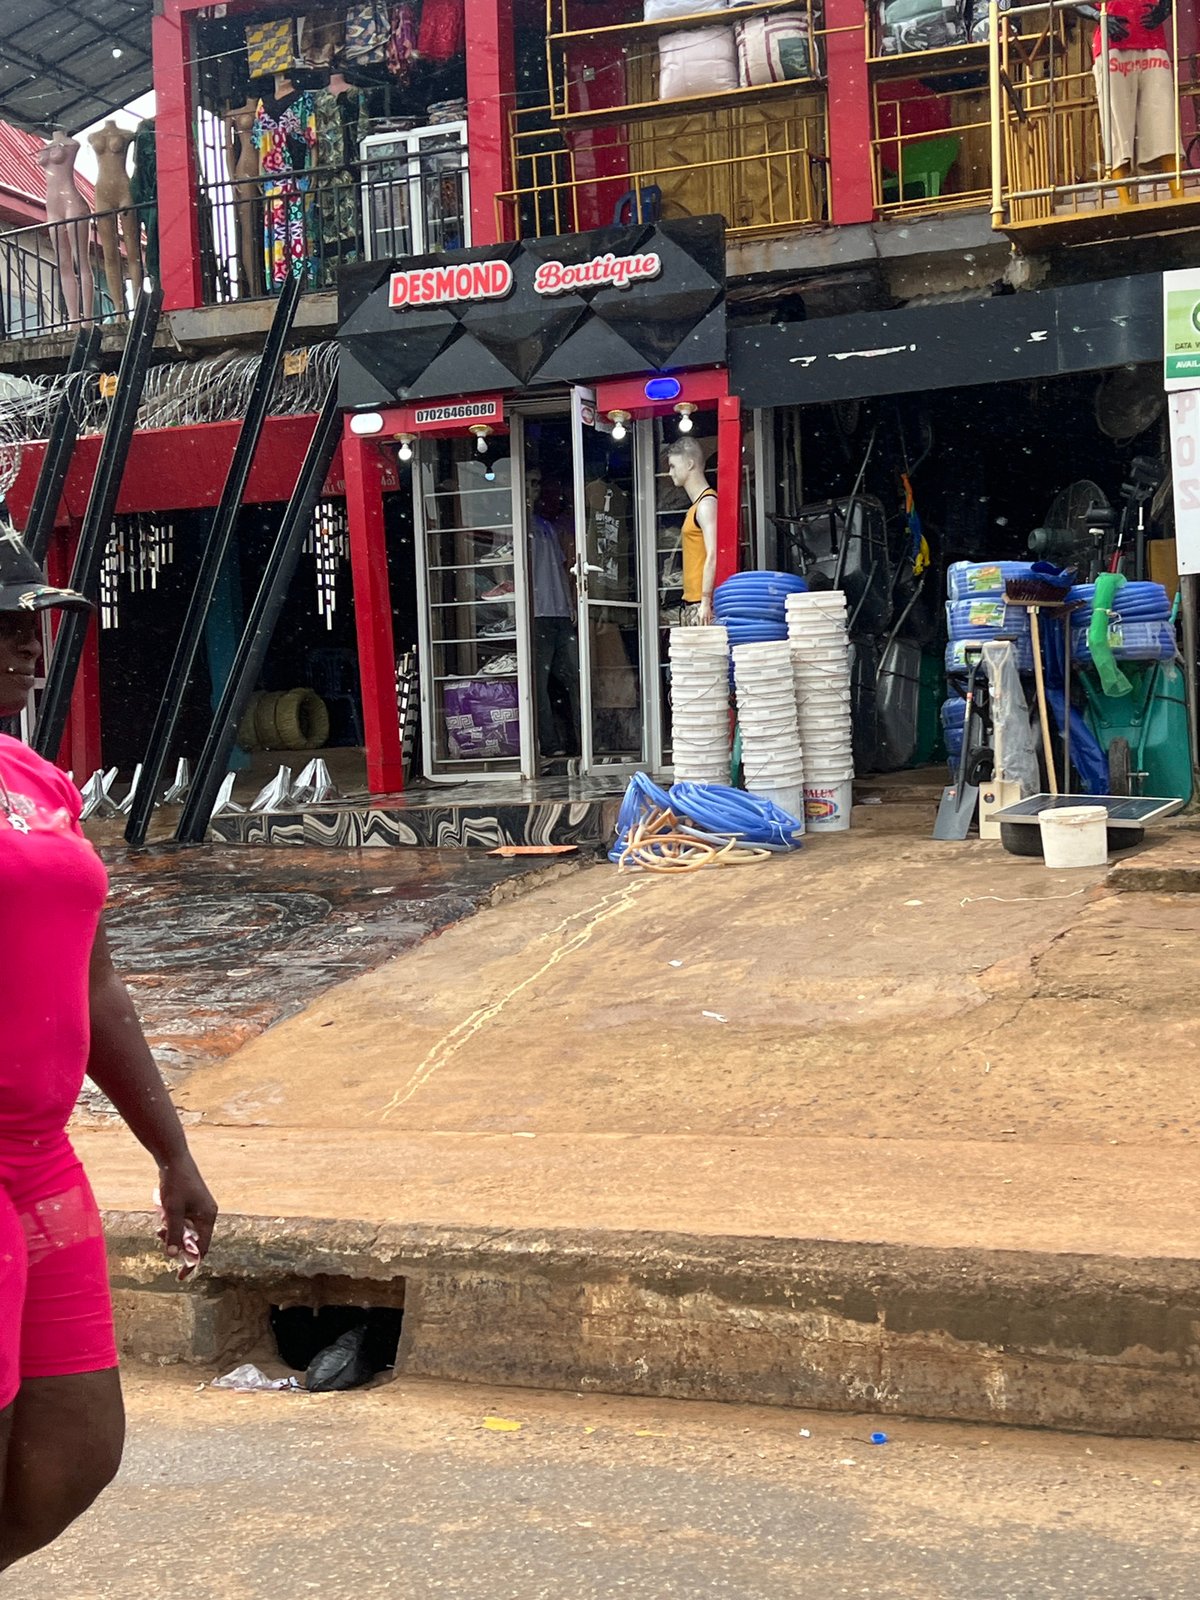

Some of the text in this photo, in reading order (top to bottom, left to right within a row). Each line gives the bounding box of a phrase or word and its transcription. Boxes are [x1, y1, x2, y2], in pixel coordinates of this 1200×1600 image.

[1109, 57, 1170, 77] Supreme
[390, 254, 658, 305] DESMOND Boutique
[1175, 342, 1192, 350] DATA
[1175, 360, 1200, 369] AVAIL
[416, 403, 495, 422] 07026466080
